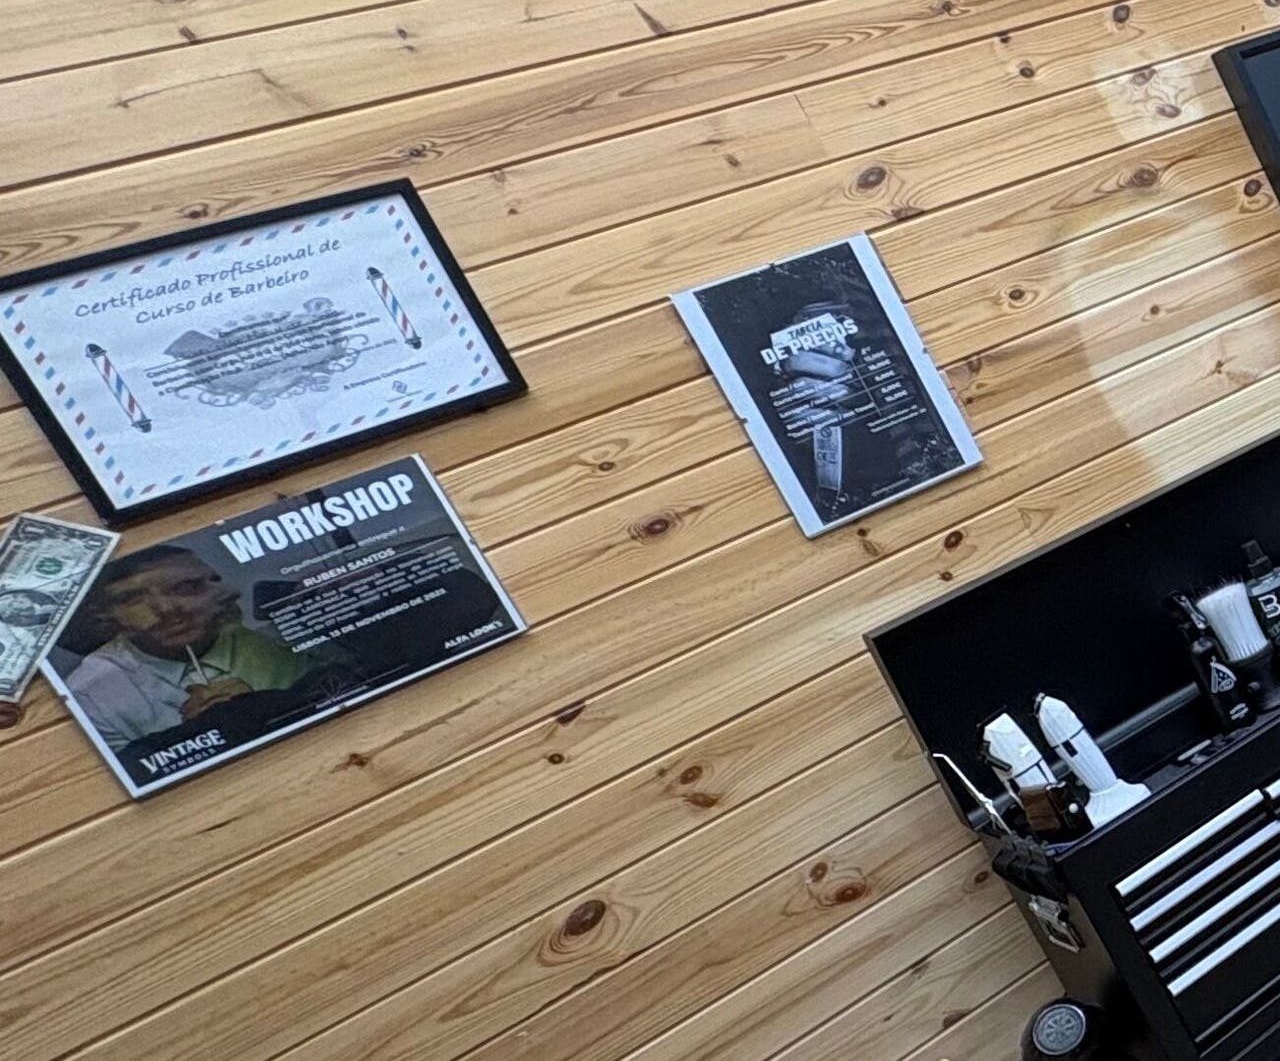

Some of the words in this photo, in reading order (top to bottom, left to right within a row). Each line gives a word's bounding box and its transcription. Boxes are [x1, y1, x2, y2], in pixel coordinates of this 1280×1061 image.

[75, 278, 190, 317] Certificado
[197, 245, 315, 286] Profissional
[320, 238, 341, 253] de
[136, 298, 196, 323] Curso
[201, 291, 223, 307] de
[229, 269, 309, 299] Barbeiro
[760, 345, 789, 365] DE
[788, 319, 859, 355] PREÇOS
[219, 473, 415, 564] WORKSHOP
[303, 566, 347, 587] RUBEN
[347, 548, 396, 569] SANTOS
[139, 728, 226, 774] VINTAGE
